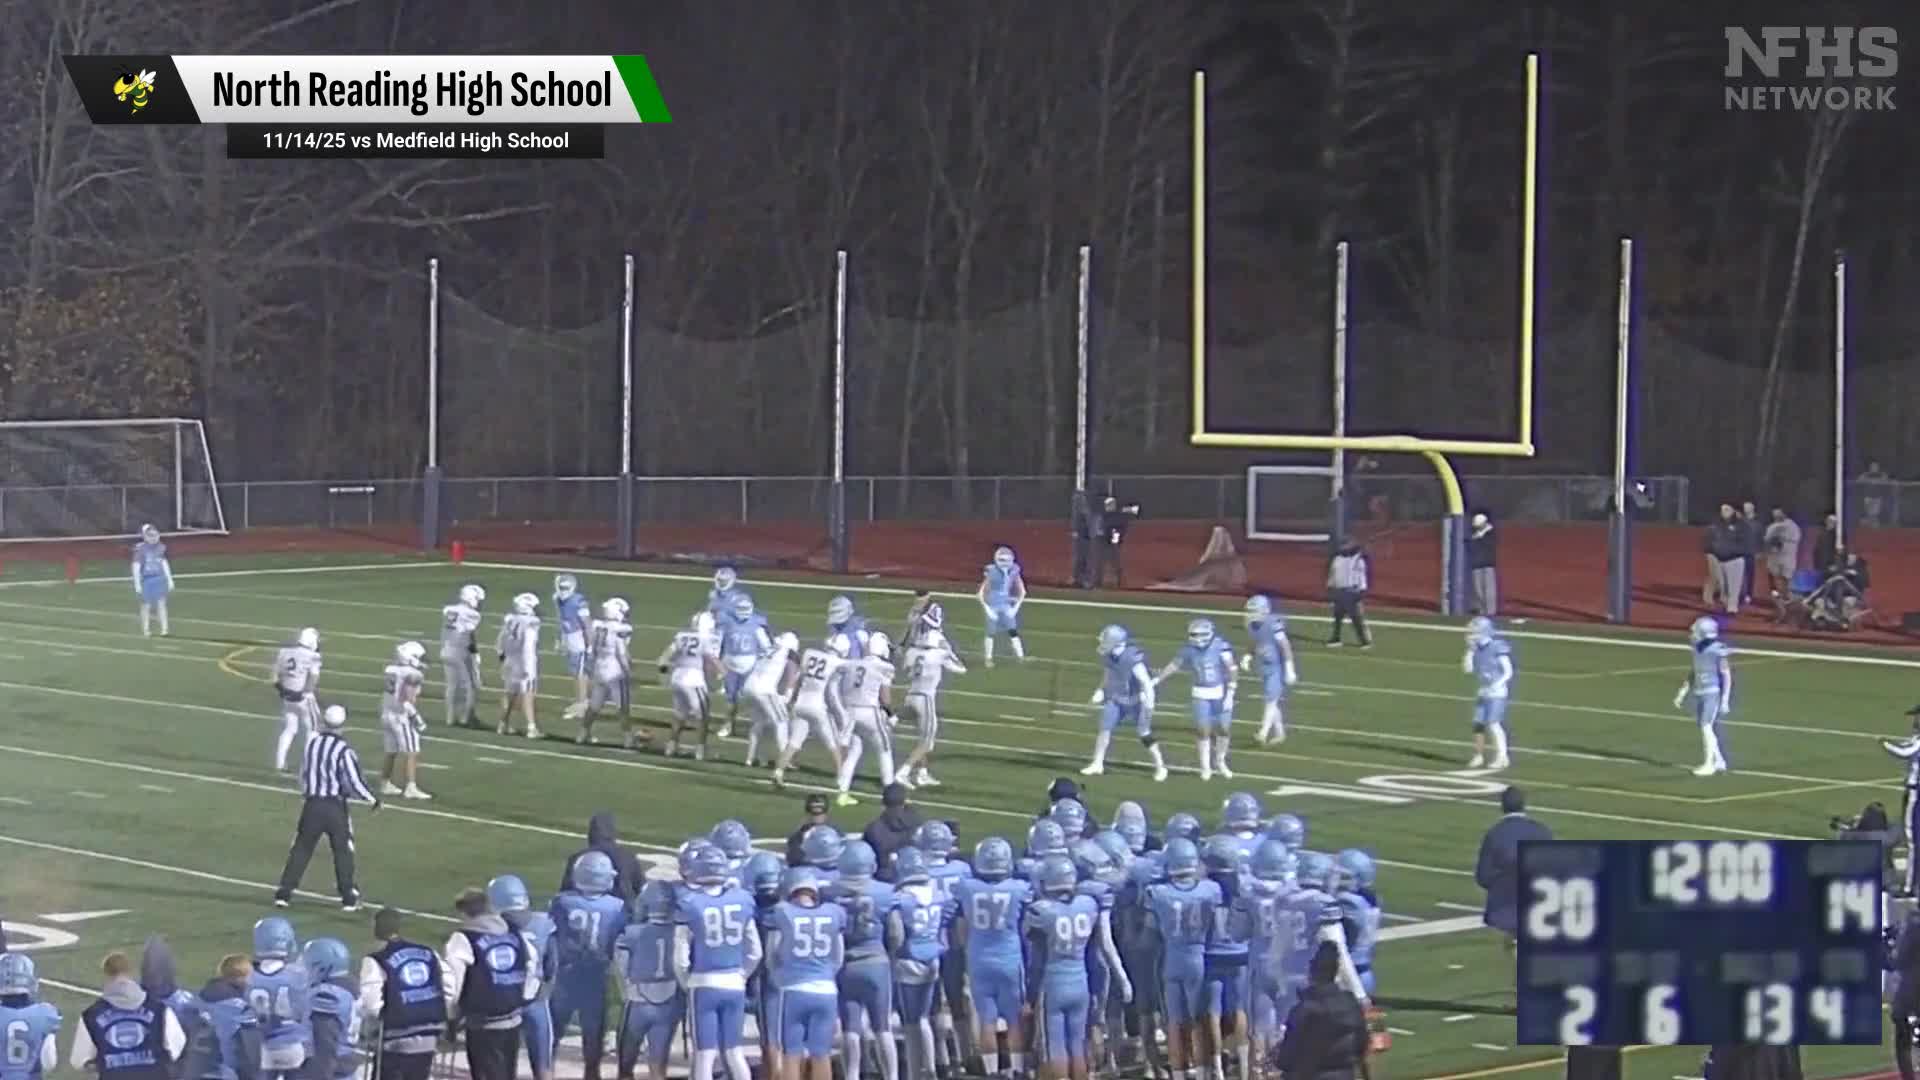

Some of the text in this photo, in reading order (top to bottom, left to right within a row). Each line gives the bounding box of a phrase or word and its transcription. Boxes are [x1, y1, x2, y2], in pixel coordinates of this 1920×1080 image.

[808, 656, 827, 680] 22
[854, 666, 867, 688] 3
[703, 903, 743, 947] 85
[972, 892, 1011, 929] 67
[792, 916, 832, 957] 55
[7, 1020, 30, 1065] 6
